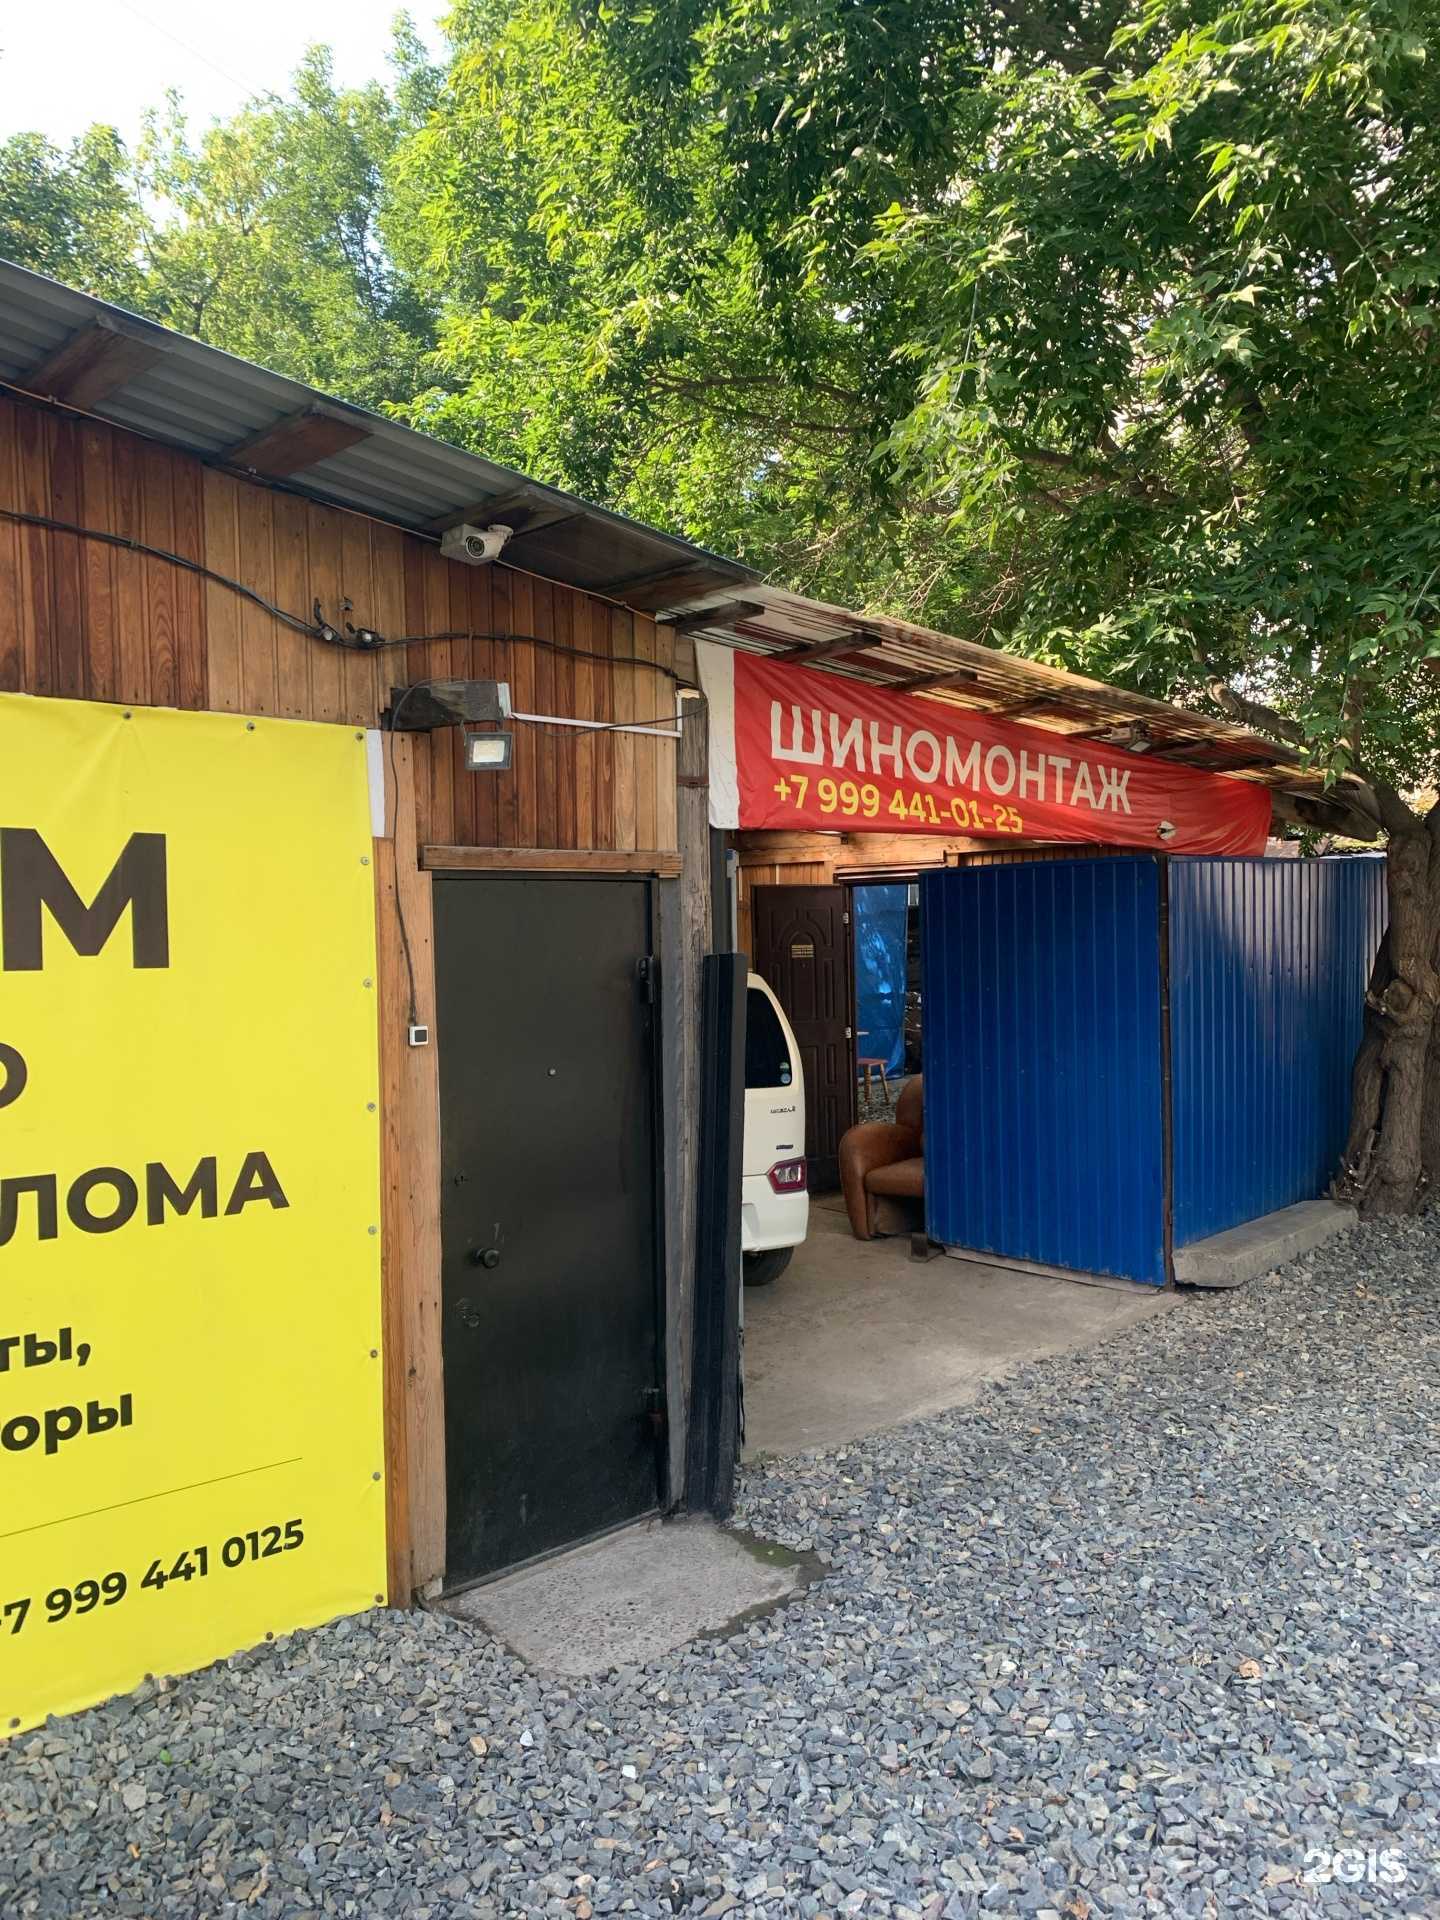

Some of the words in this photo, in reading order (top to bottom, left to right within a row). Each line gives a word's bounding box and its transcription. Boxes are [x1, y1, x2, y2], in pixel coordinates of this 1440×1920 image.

[770, 700, 1132, 815] ШИНОМОНТАЖ
[773, 774, 809, 809] +7
[817, 777, 880, 818] 999
[888, 789, 1023, 833] 441-01-25
[0, 1598, 31, 1635] 7
[46, 1571, 128, 1623] 999
[140, 1545, 208, 1590] 441
[222, 1518, 304, 1568] 0125
